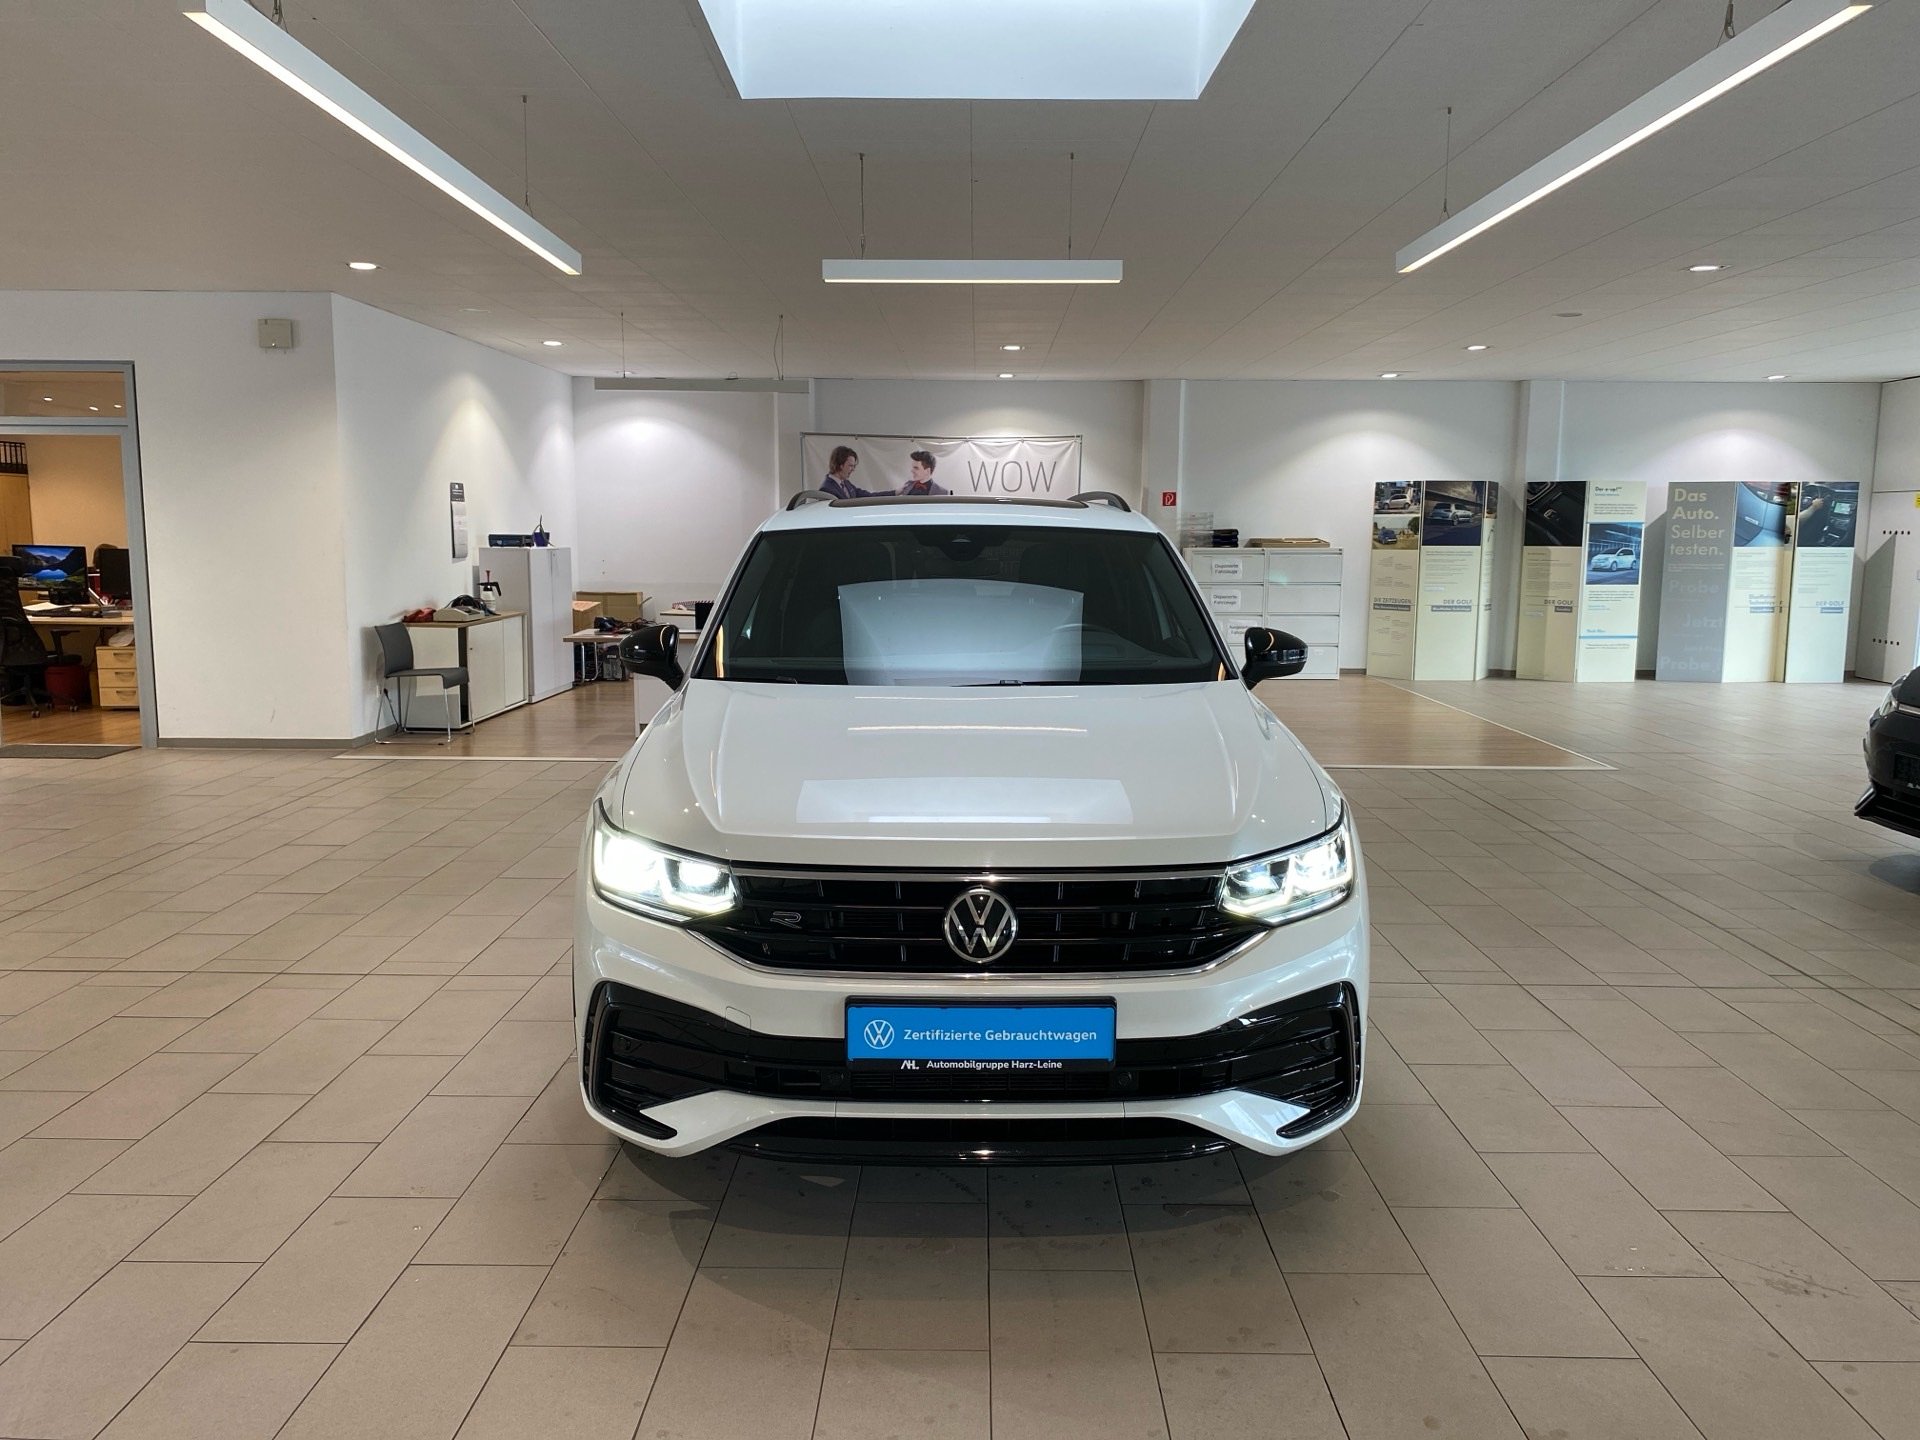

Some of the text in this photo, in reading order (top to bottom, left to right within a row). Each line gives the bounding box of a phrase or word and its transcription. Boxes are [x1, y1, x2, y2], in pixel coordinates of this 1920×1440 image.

[967, 460, 1057, 493] WOW
[1674, 488, 1707, 502] Das
[1672, 506, 1720, 520] Auto.
[1671, 524, 1725, 539] Selber
[1670, 543, 1724, 556] testen.
[1668, 579, 1720, 593] Probe
[903, 1028, 982, 1041] Zertifizierte
[985, 1029, 1097, 1044] Gebrauchtwagen
[926, 1060, 1010, 1071] Automobilgruppe
[1011, 1060, 1063, 1070] Harz-Leine
